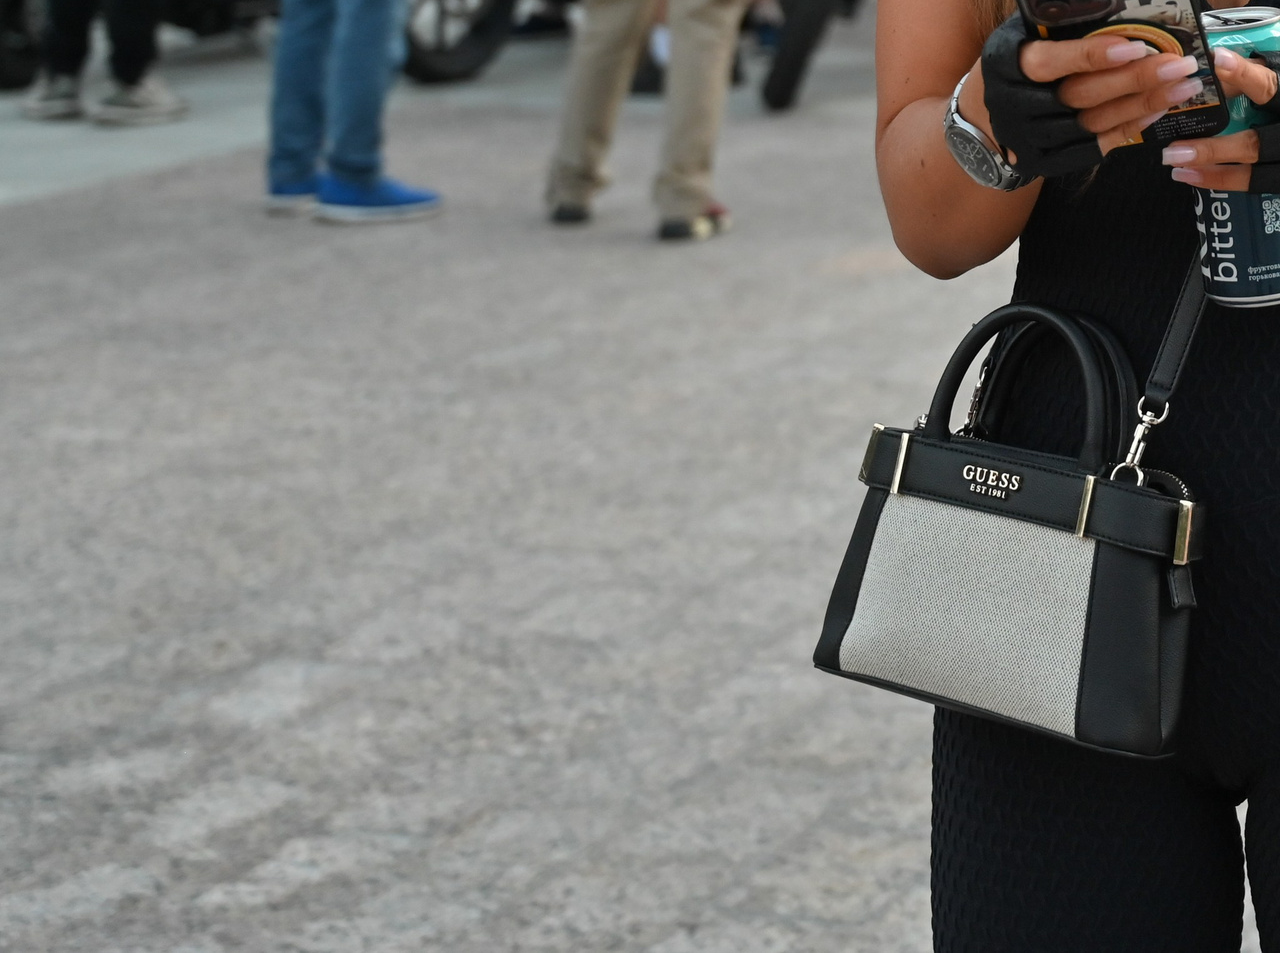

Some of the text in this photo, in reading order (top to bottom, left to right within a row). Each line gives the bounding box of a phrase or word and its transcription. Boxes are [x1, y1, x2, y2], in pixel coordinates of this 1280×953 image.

[1209, 189, 1239, 283] bitter
[963, 465, 1020, 490] GUESS
[970, 483, 1006, 499] EST 1981
